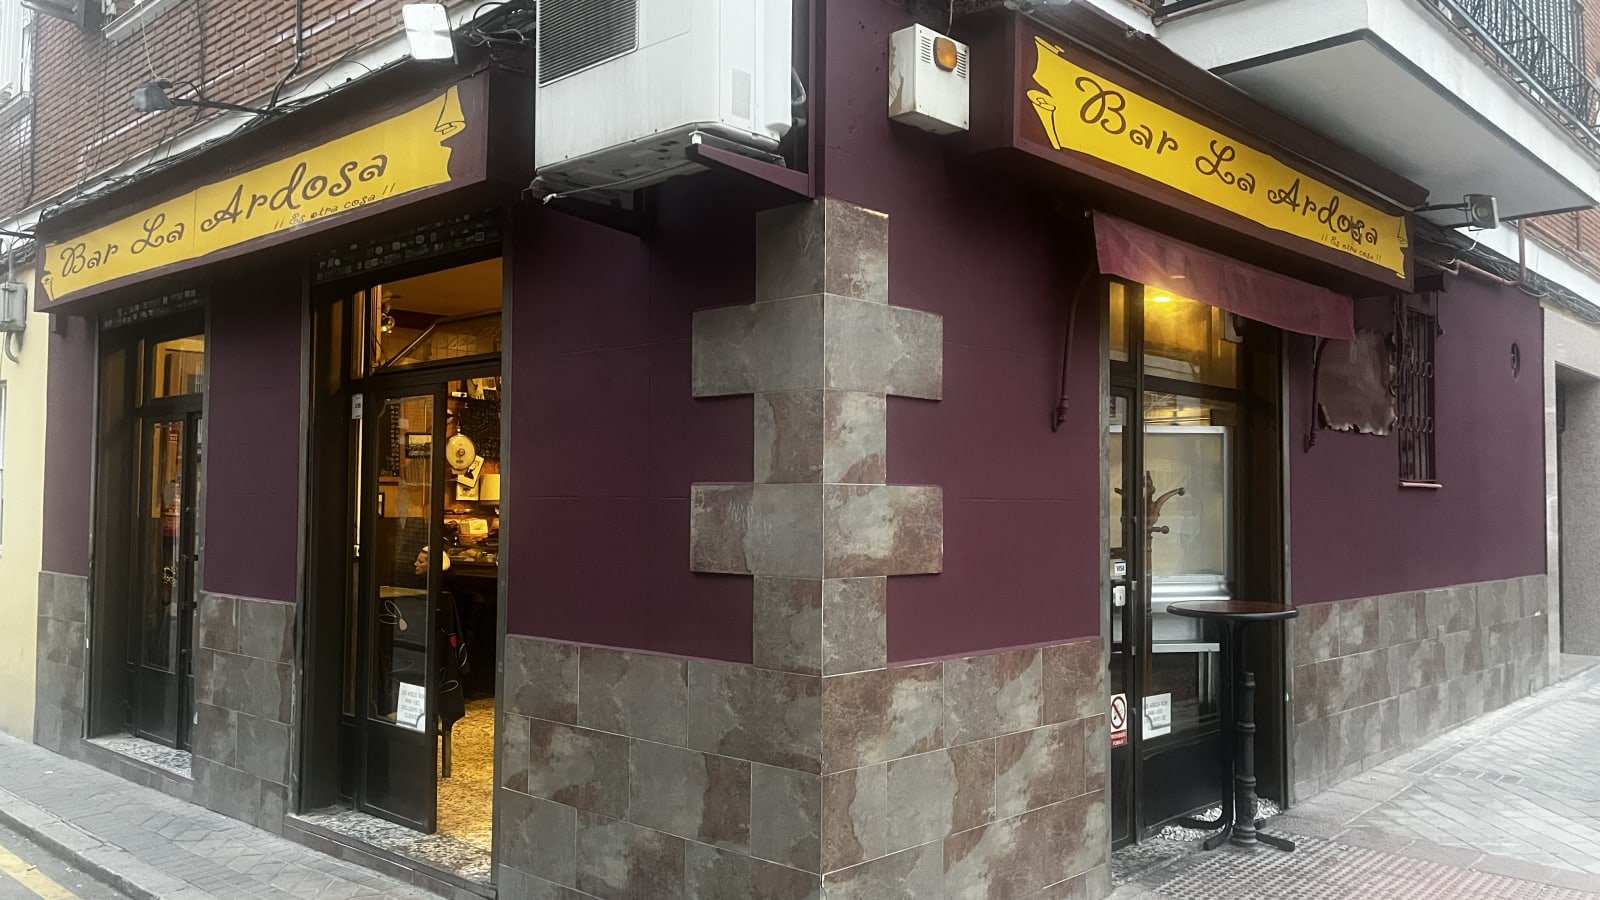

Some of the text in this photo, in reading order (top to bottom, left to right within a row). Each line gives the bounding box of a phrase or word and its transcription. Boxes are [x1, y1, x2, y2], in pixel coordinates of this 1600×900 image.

[60, 154, 388, 278] Bar La Ardosa
[310, 205, 339, 219] otra
[344, 194, 376, 209] cosa
[1074, 76, 1378, 245] Bar La Ardosa
